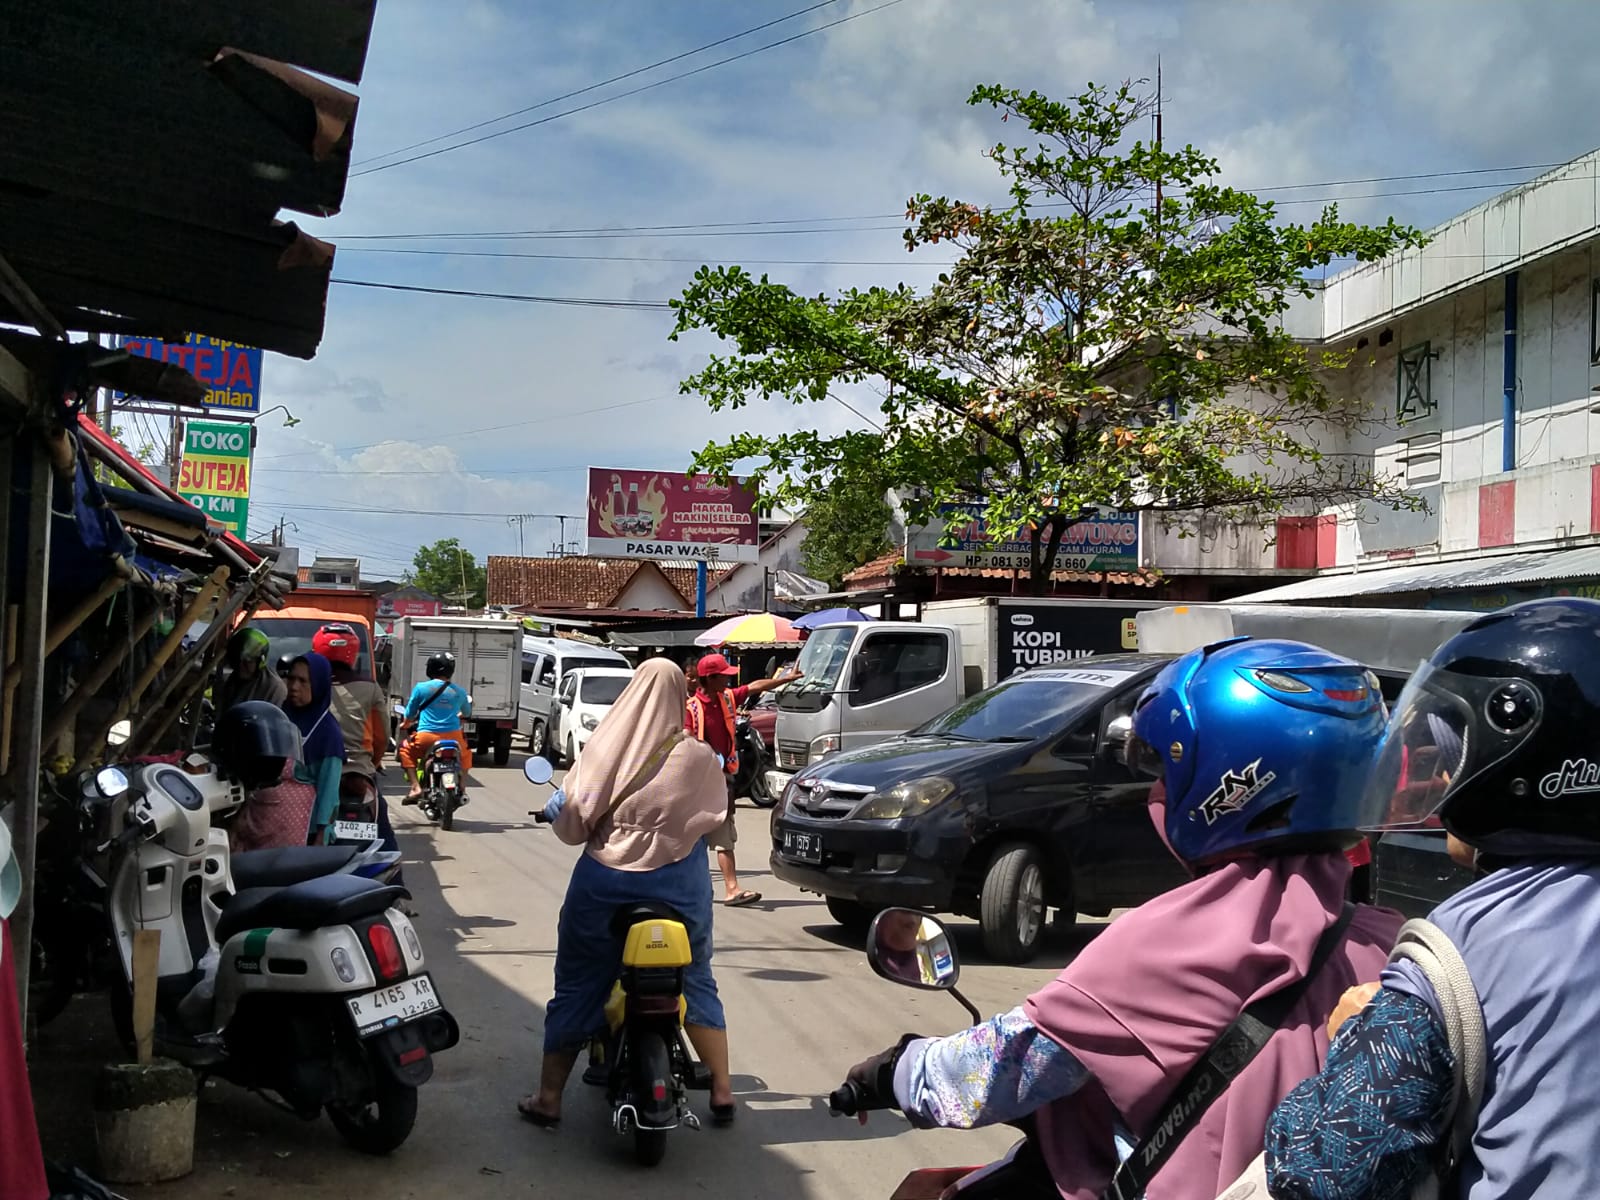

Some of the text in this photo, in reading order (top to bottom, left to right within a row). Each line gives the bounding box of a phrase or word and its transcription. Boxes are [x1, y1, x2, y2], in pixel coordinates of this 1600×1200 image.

[189, 430, 243, 451] TOKO
[180, 460, 247, 493] SUTEJA
[208, 497, 236, 513] KM
[693, 504, 731, 513] MAKAN
[674, 512, 751, 523] MAKIN SELERA
[626, 543, 674, 555] PASAR
[1082, 546, 1122, 554] UKURAN
[965, 555, 982, 566] HP
[991, 556, 1012, 567] 081
[1065, 558, 1087, 569] 660
[1012, 631, 1061, 647] KOPI
[350, 979, 430, 1016] R 4165 XR
